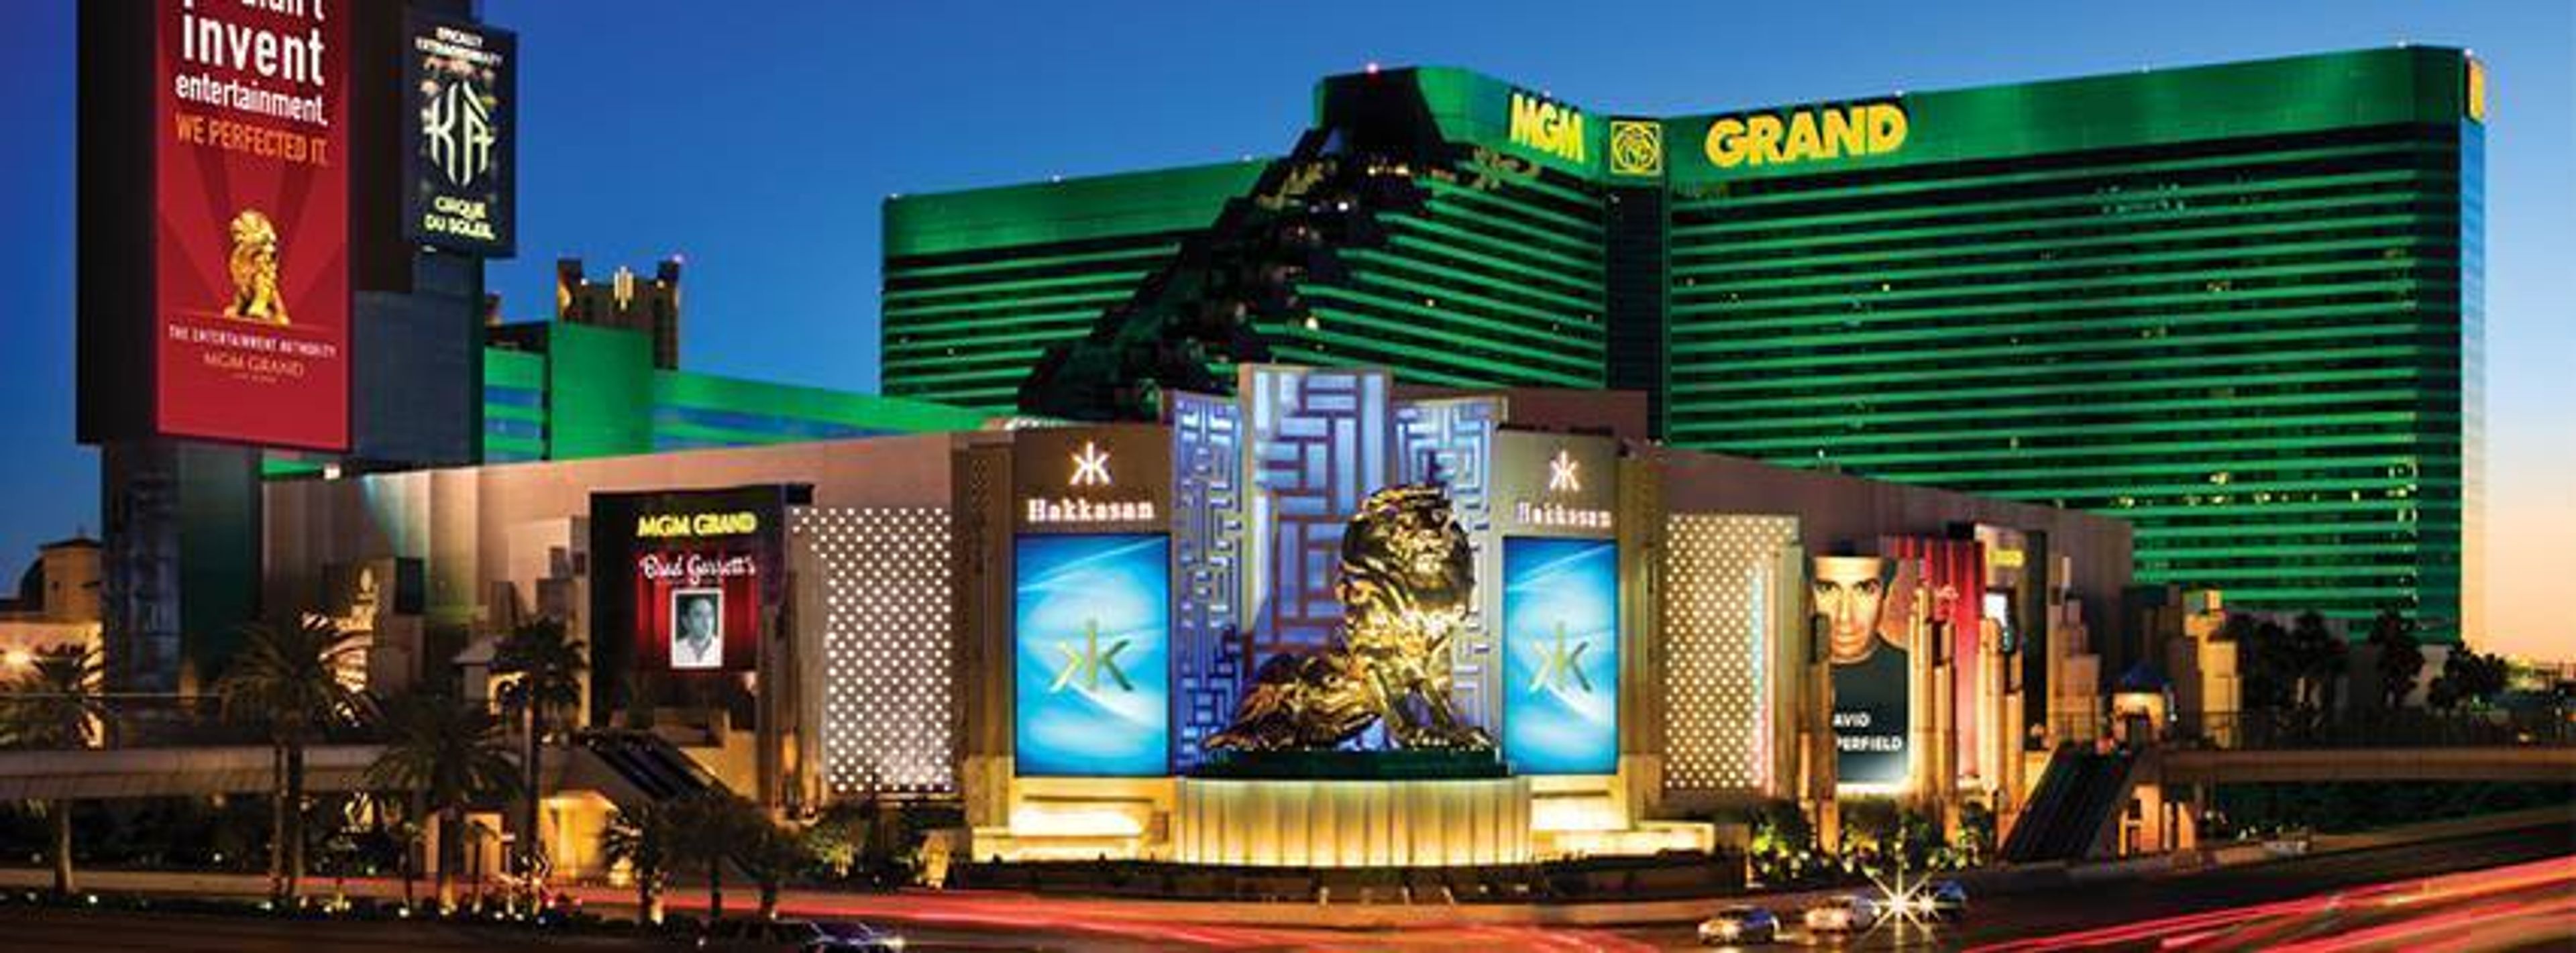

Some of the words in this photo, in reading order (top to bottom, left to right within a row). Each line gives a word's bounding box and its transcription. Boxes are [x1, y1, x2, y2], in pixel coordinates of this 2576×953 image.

[184, 15, 325, 86] invent
[175, 113, 205, 145] WE
[208, 117, 307, 162] PERFECTED
[1509, 93, 1585, 164] MGM
[1704, 103, 1907, 169] GRAND
[435, 195, 486, 221] CIRQUE
[423, 213, 447, 231] DU
[1028, 498, 1154, 522] Hakkasan
[1516, 502, 1612, 528] Hakkasan
[637, 515, 691, 537] MGM
[693, 512, 757, 536] GRAND
